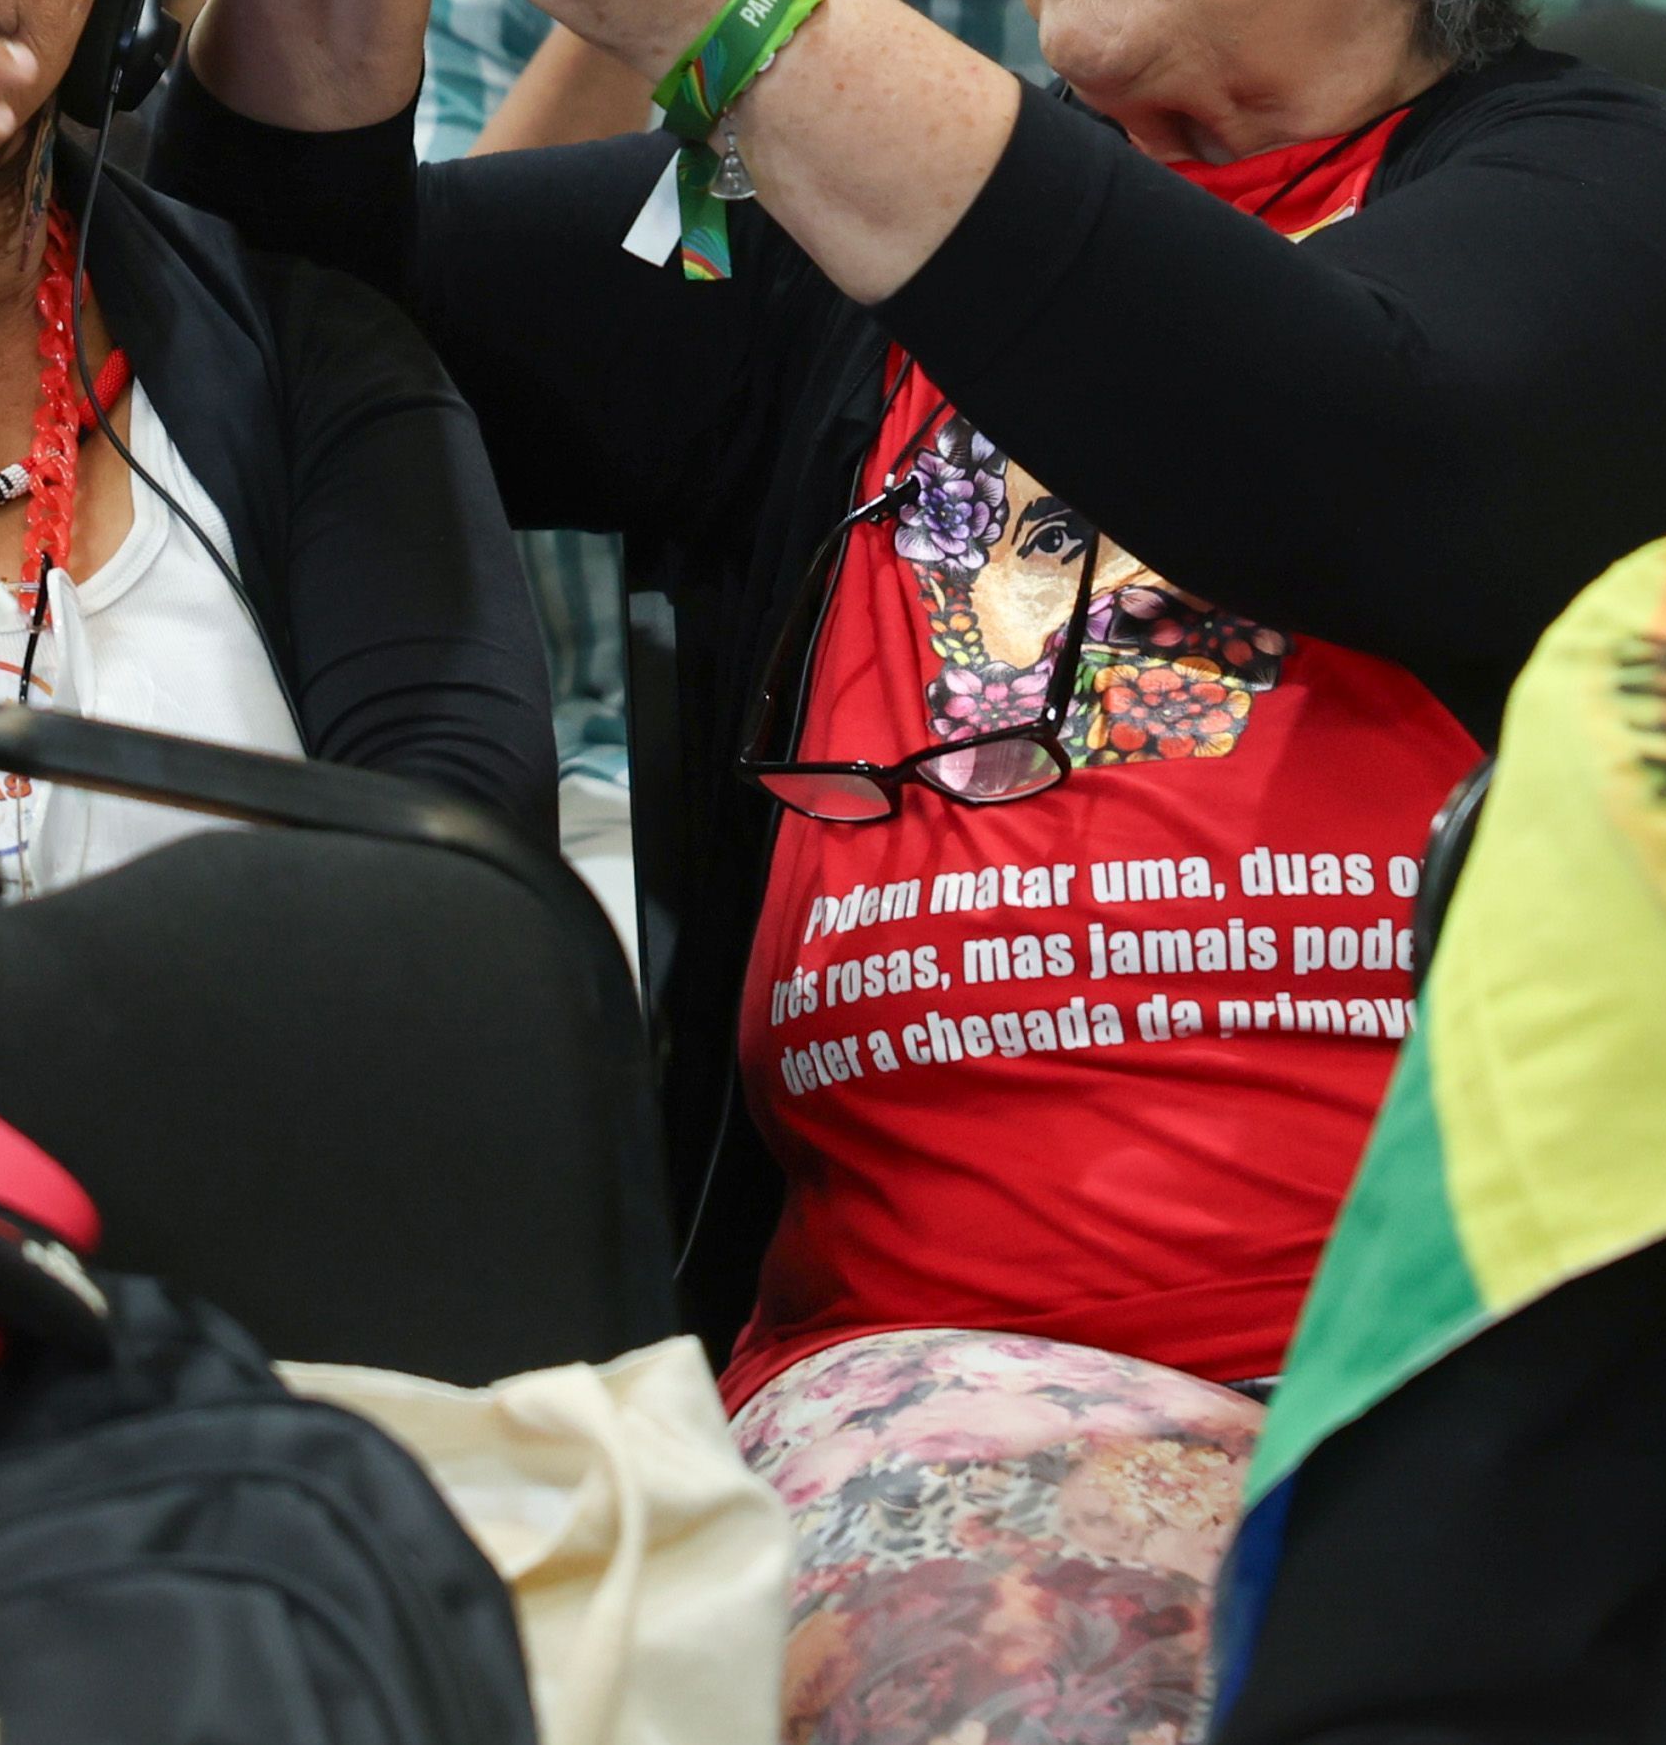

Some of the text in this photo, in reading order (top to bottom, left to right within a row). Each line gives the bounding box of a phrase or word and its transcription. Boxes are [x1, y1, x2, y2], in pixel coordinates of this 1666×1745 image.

[803, 846, 1425, 945] Podem matar uma, duas o
[771, 965, 820, 1026] três
[826, 944, 951, 1008] rosas,
[964, 932, 1075, 985] mas
[1087, 918, 1277, 980] jamais
[781, 1035, 865, 1096] deter
[867, 1030, 901, 1073] a
[902, 996, 1124, 1067] chegada
[1136, 994, 1204, 1043] da
